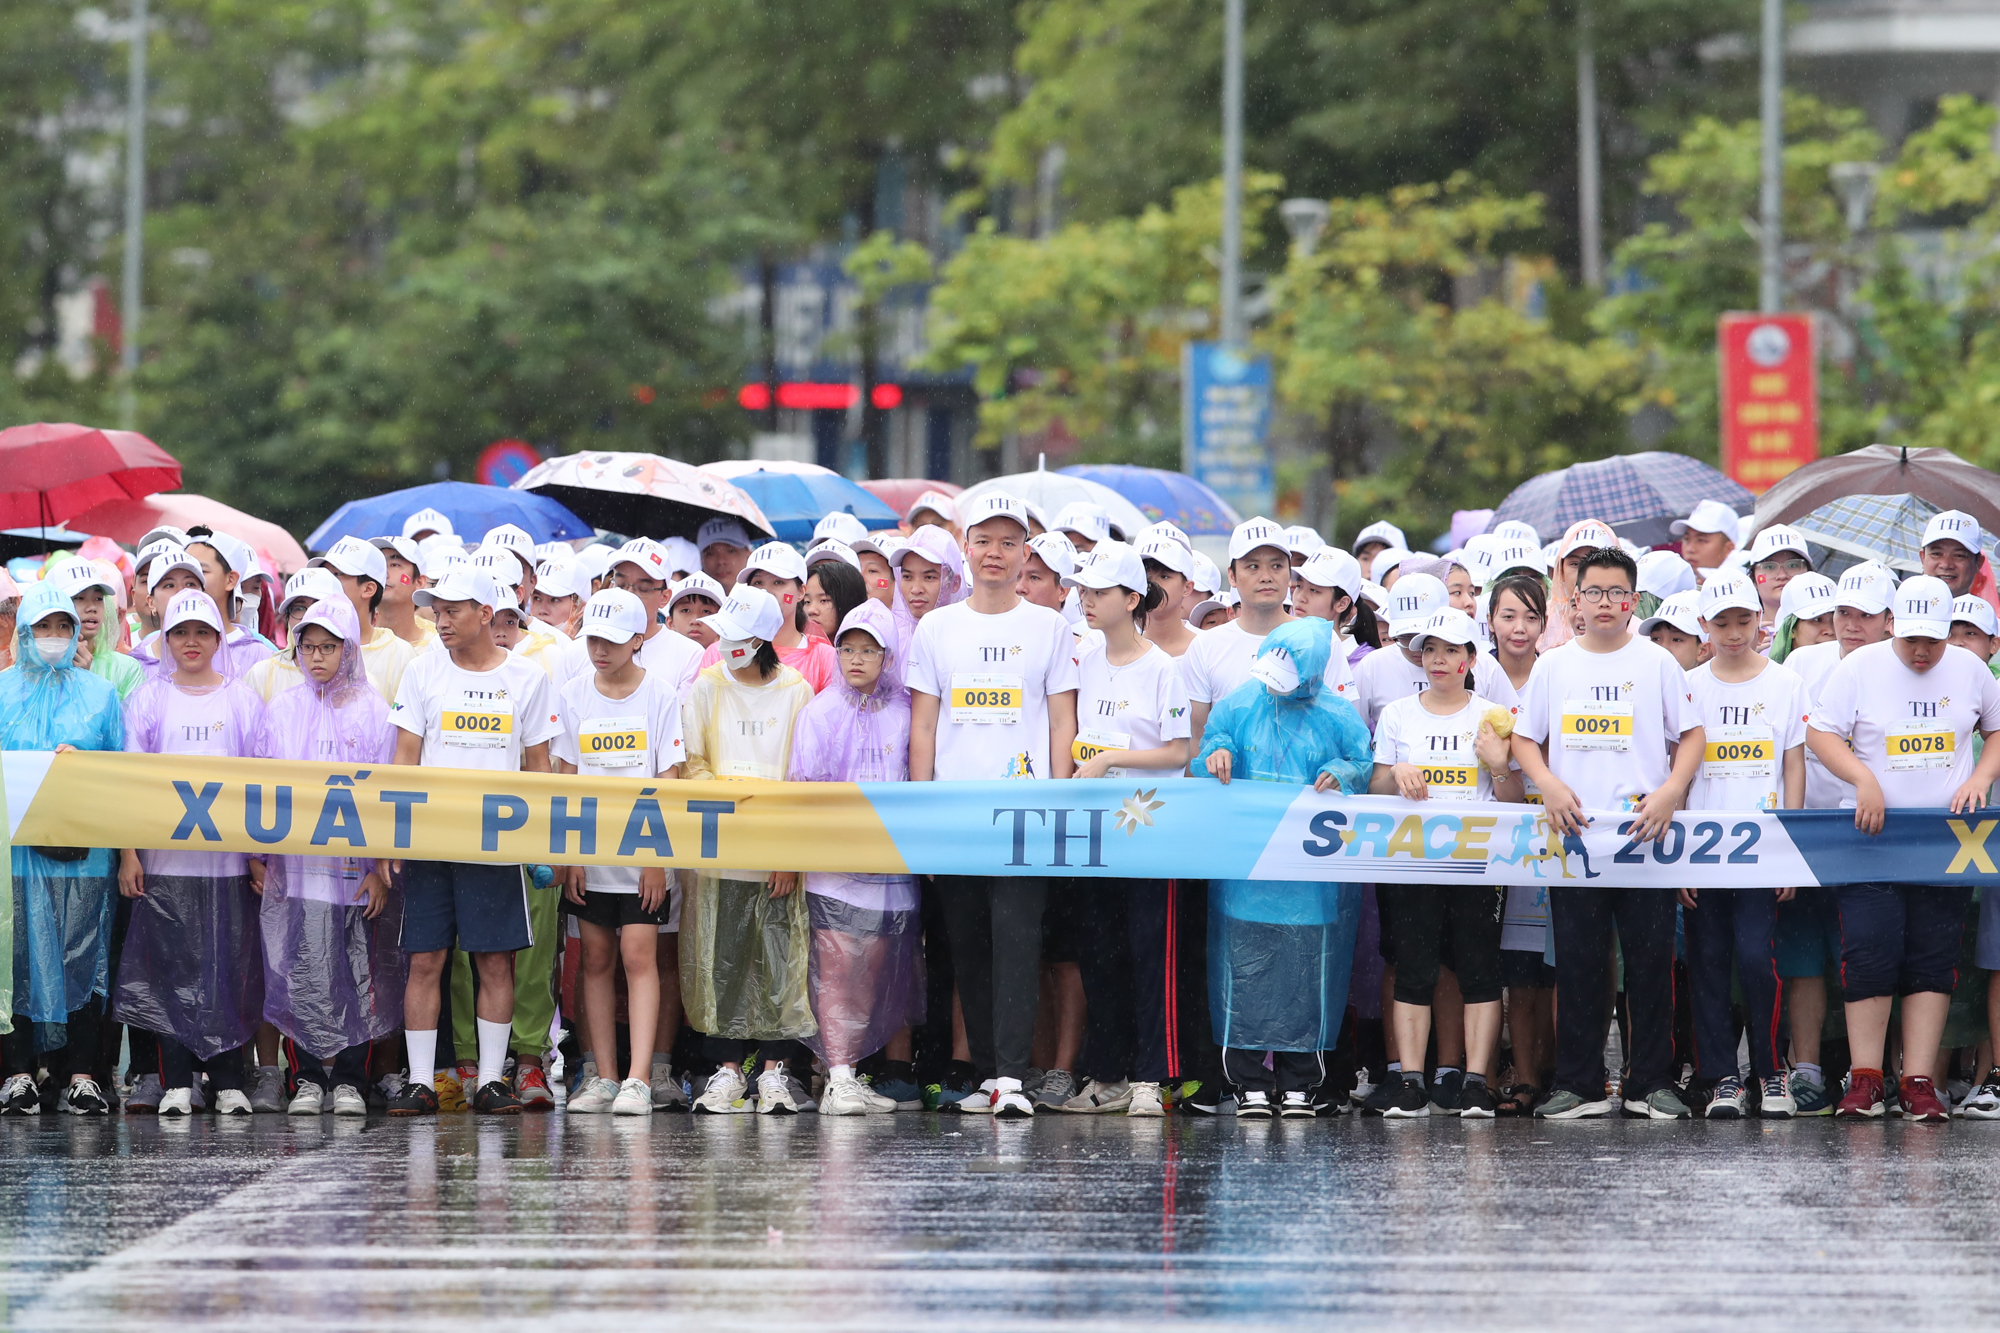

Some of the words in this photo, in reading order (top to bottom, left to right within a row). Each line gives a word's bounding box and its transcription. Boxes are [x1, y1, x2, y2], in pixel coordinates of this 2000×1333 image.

[986, 498, 1009, 510] TH
[1938, 519, 1961, 531] TH
[493, 534, 515, 545] TH
[1243, 526, 1267, 540] TH
[1575, 529, 1596, 541] TH
[1767, 534, 1790, 546] TH
[625, 542, 645, 553] TH
[1501, 547, 1523, 561] TH
[161, 554, 185, 565] TH
[473, 556, 493, 566] TH
[753, 549, 772, 562] TH
[67, 566, 92, 579] TH
[289, 575, 305, 592] TH
[1710, 583, 1733, 598] TH
[1843, 576, 1863, 591] TH
[1805, 585, 1831, 599] TH
[591, 604, 612, 618] TH
[1397, 597, 1419, 611] TH
[1659, 605, 1677, 616] TH
[1906, 600, 1929, 614] TH
[1953, 602, 1974, 613] TH
[1427, 616, 1444, 629] TH
[979, 647, 1006, 662] TH
[965, 691, 1011, 706] 0038
[1591, 686, 1619, 701] TH
[1097, 700, 1116, 717] TH
[1720, 706, 1750, 725] TH
[1909, 701, 1937, 717] TH
[455, 715, 501, 731] 0002
[737, 720, 763, 736] TH
[1575, 718, 1620, 733] 0091
[181, 725, 210, 741] TH
[591, 735, 636, 751] 0002
[1425, 735, 1459, 751] TH
[1899, 736, 1945, 753] 0078
[1717, 744, 1763, 760] 0096
[1423, 769, 1467, 785] 0055
[170, 770, 428, 848] XUẤT
[481, 788, 735, 858] PHÁT
[992, 808, 1110, 867] TH
[1613, 820, 1762, 864] 2022
[1945, 819, 2000, 874] X
